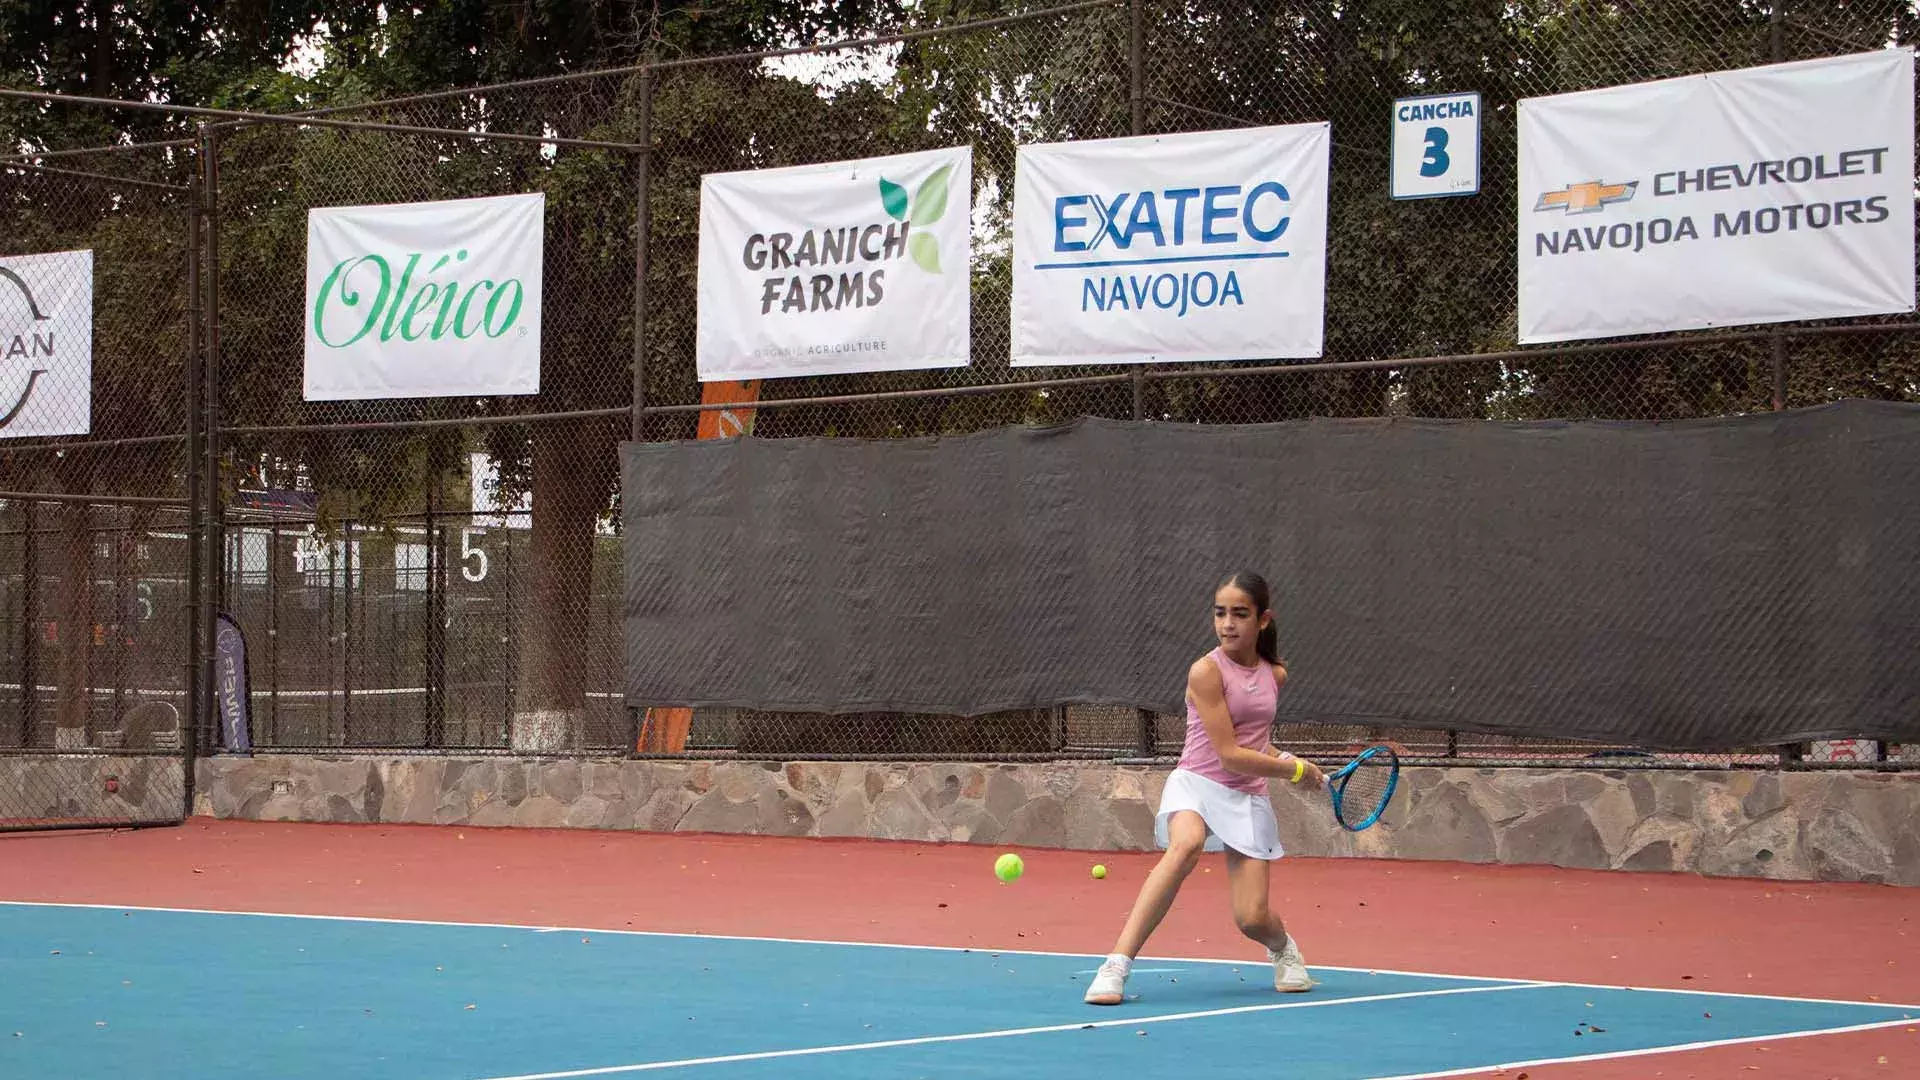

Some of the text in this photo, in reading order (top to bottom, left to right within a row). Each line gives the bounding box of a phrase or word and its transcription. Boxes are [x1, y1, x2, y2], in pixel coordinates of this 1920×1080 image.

[1398, 101, 1474, 122] CANCHA
[1420, 127, 1450, 177] 3
[1653, 147, 1889, 197] CHEVROLET
[1054, 181, 1291, 252] EXATEC
[1535, 196, 1889, 257] NAVOJOA MOTORS
[743, 220, 910, 271] GRANICH
[314, 249, 524, 348] Oléico
[760, 269, 885, 315] FARMS
[1082, 270, 1244, 318] NAVOJOA
[0, 331, 55, 359] AN
[807, 341, 887, 355] AGRICULTURE
[462, 527, 488, 582] 5
